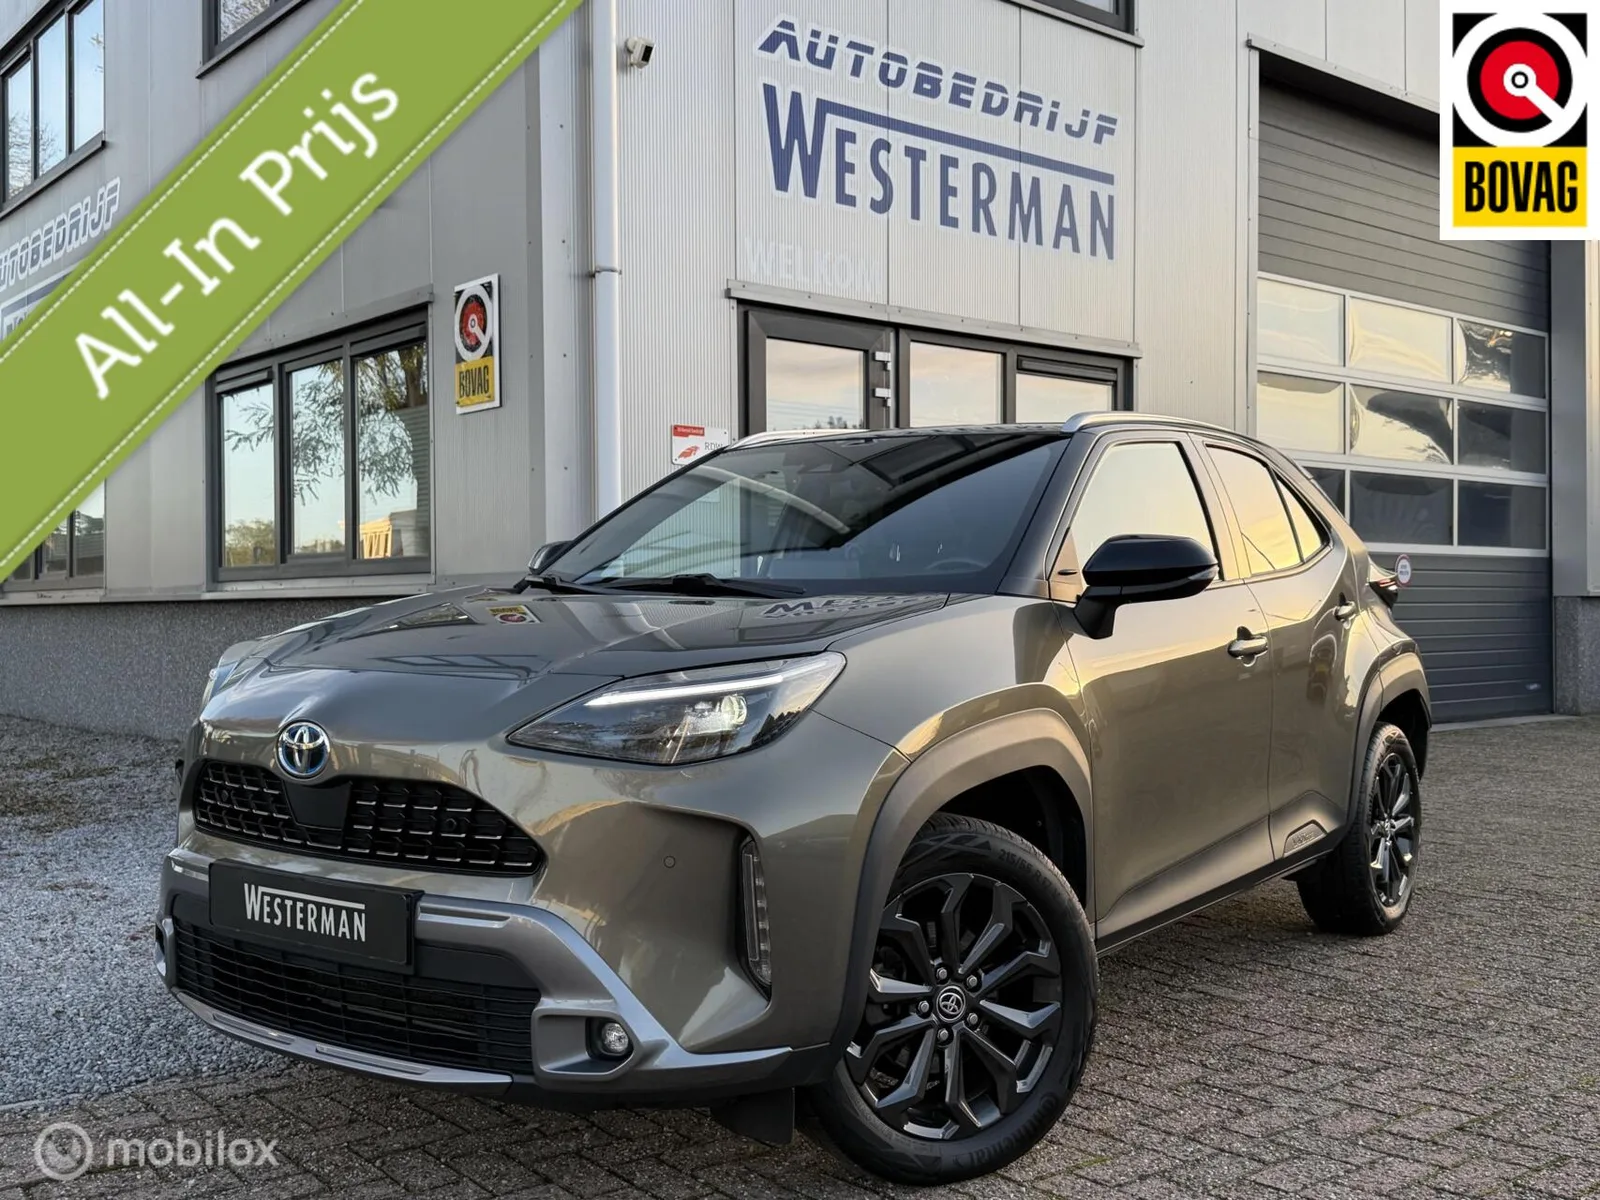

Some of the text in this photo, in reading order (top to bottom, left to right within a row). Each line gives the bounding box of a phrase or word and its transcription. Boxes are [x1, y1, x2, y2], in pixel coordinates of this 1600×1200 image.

[758, 20, 1118, 145] AUTOBEDRIJF
[763, 82, 1115, 261] WESTERMAN
[0, 178, 120, 290] UTOBEDRIJF
[459, 365, 489, 398] BOVAG
[244, 883, 366, 942] WESTERMAN
